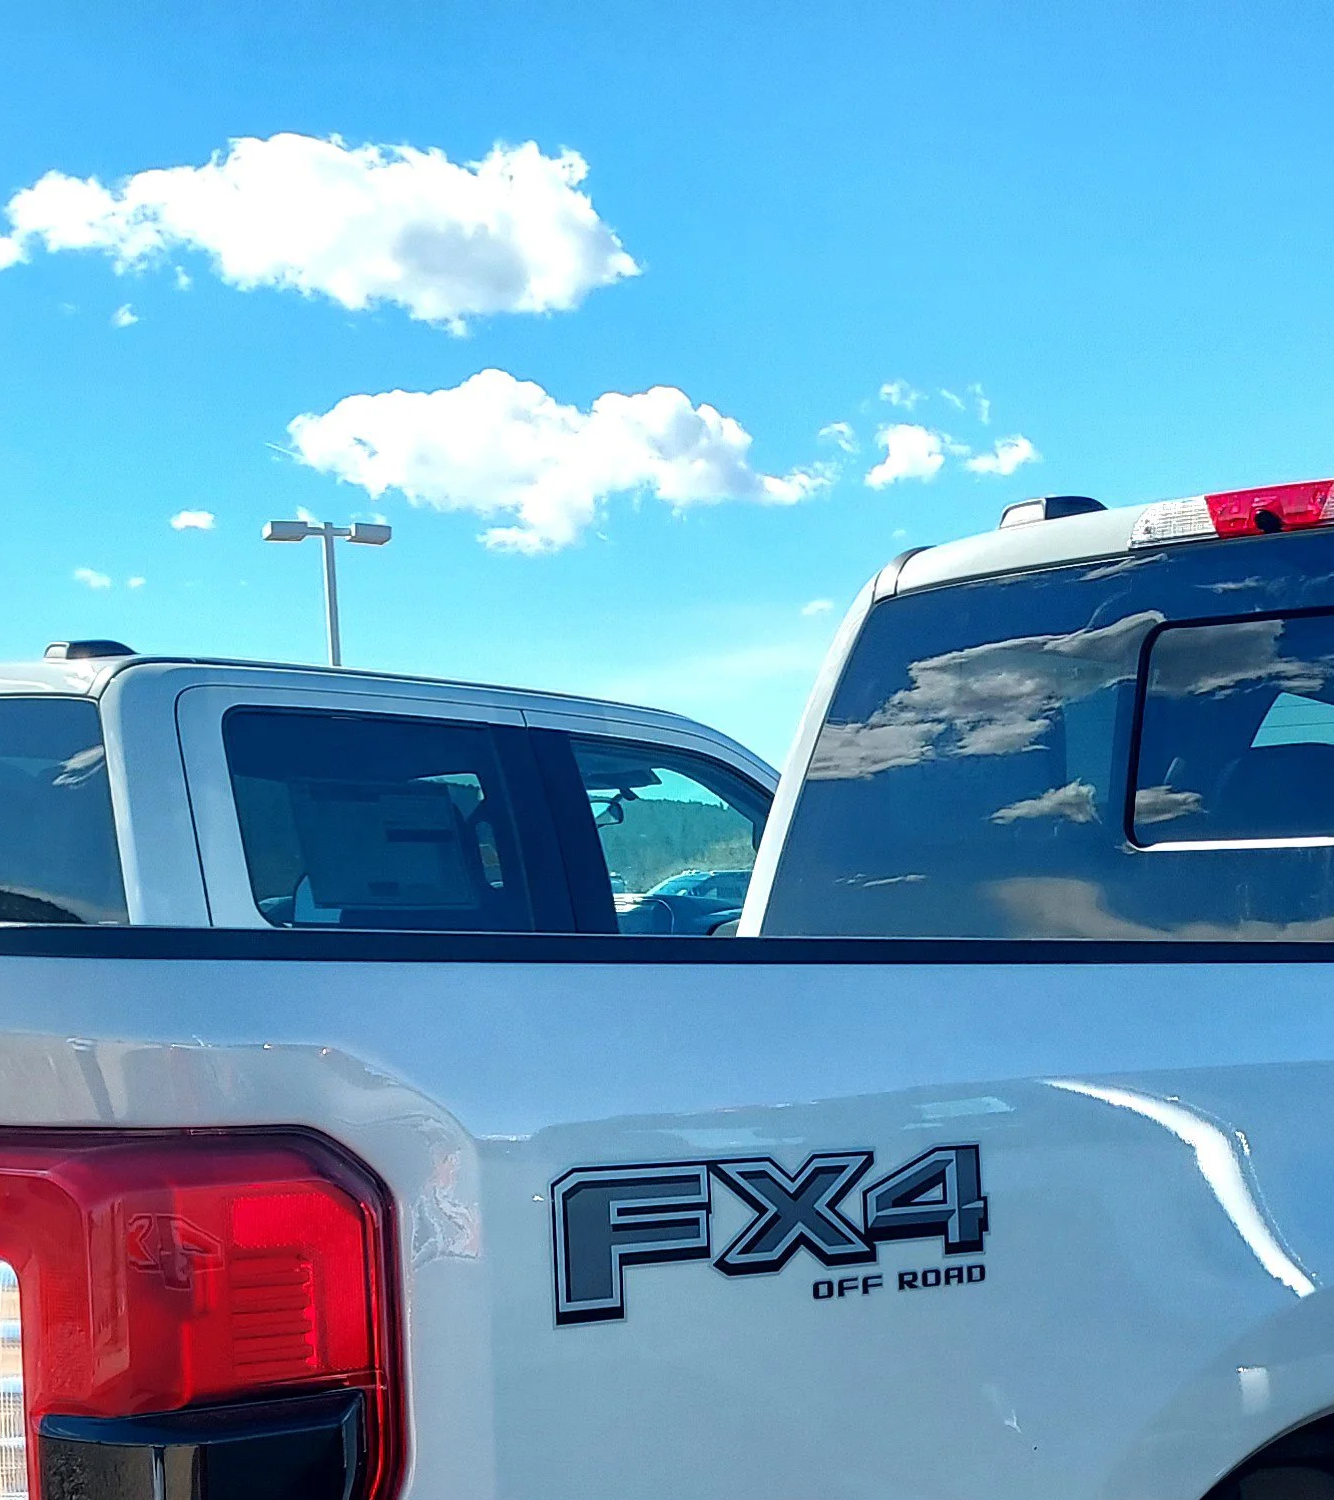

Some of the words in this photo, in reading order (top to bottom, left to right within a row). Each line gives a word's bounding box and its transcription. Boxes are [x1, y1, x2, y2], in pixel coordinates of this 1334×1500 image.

[549, 1141, 991, 1330] FX4
[811, 1275, 884, 1300] OFF
[897, 1263, 987, 1291] ROAD
